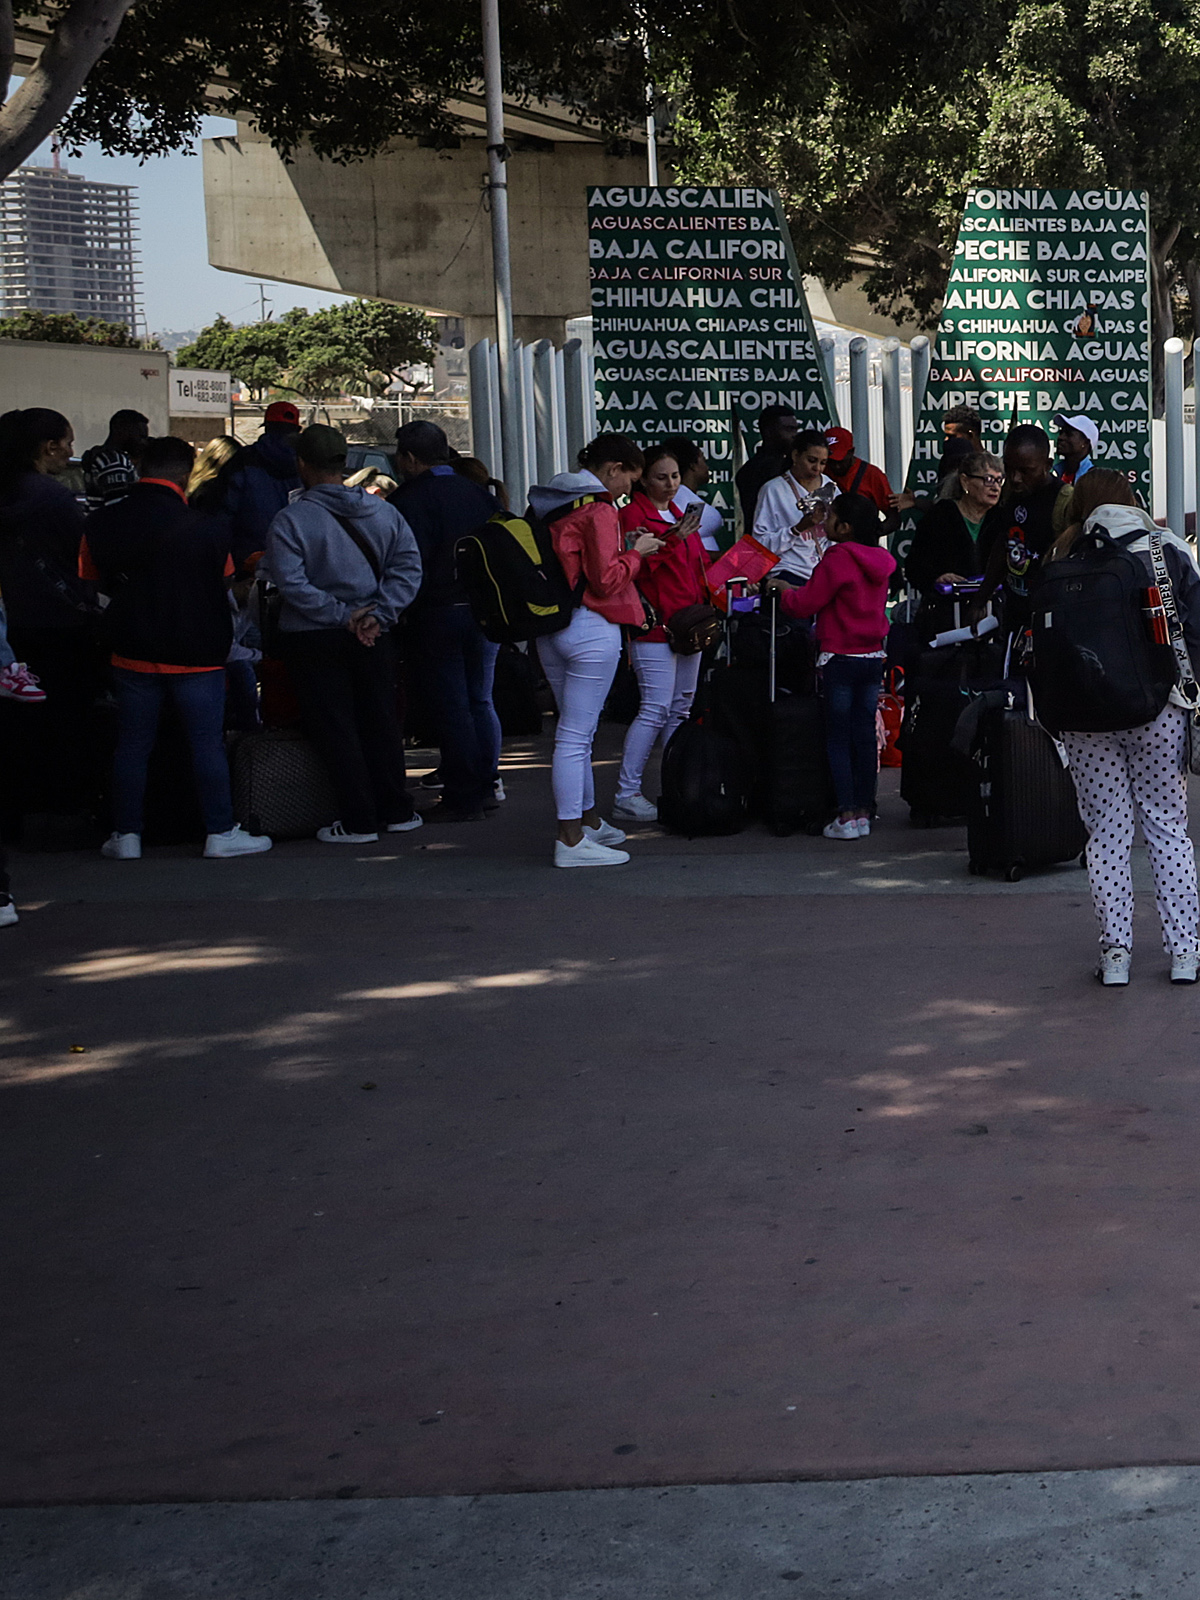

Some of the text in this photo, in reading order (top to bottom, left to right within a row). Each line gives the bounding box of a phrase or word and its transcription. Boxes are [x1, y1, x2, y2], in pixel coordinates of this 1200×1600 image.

[591, 216, 780, 231] AGUASCALIENTES BA
[1071, 218, 1117, 233] BAJA
[589, 239, 659, 259] BAJA
[1036, 240, 1105, 262] BAJA
[589, 266, 632, 280] BAJA
[638, 267, 744, 281] CALIFORNIA
[749, 267, 782, 281] SUR
[950, 268, 1042, 283] ALIFORNIA
[1047, 269, 1080, 283] SUR
[591, 287, 742, 308] CHIHUAHUA
[1026, 289, 1136, 311] CHIAPAS
[592, 318, 691, 332] CHIHUAHUA
[695, 318, 770, 332] CHIAPAS
[958, 319, 1060, 334] CHIHUAHUA
[593, 339, 817, 360] AGUASCALIENTES
[594, 367, 749, 382] AGUASCALIENTES
[754, 368, 800, 382] BAJA
[930, 367, 1149, 383] BAJA CALIFORNIA AGUAS
[176, 380, 193, 397] Tel
[594, 390, 824, 411] BAJA CALIFORNIA
[921, 390, 1031, 411] MPECHE
[1037, 390, 1104, 412] BAJA
